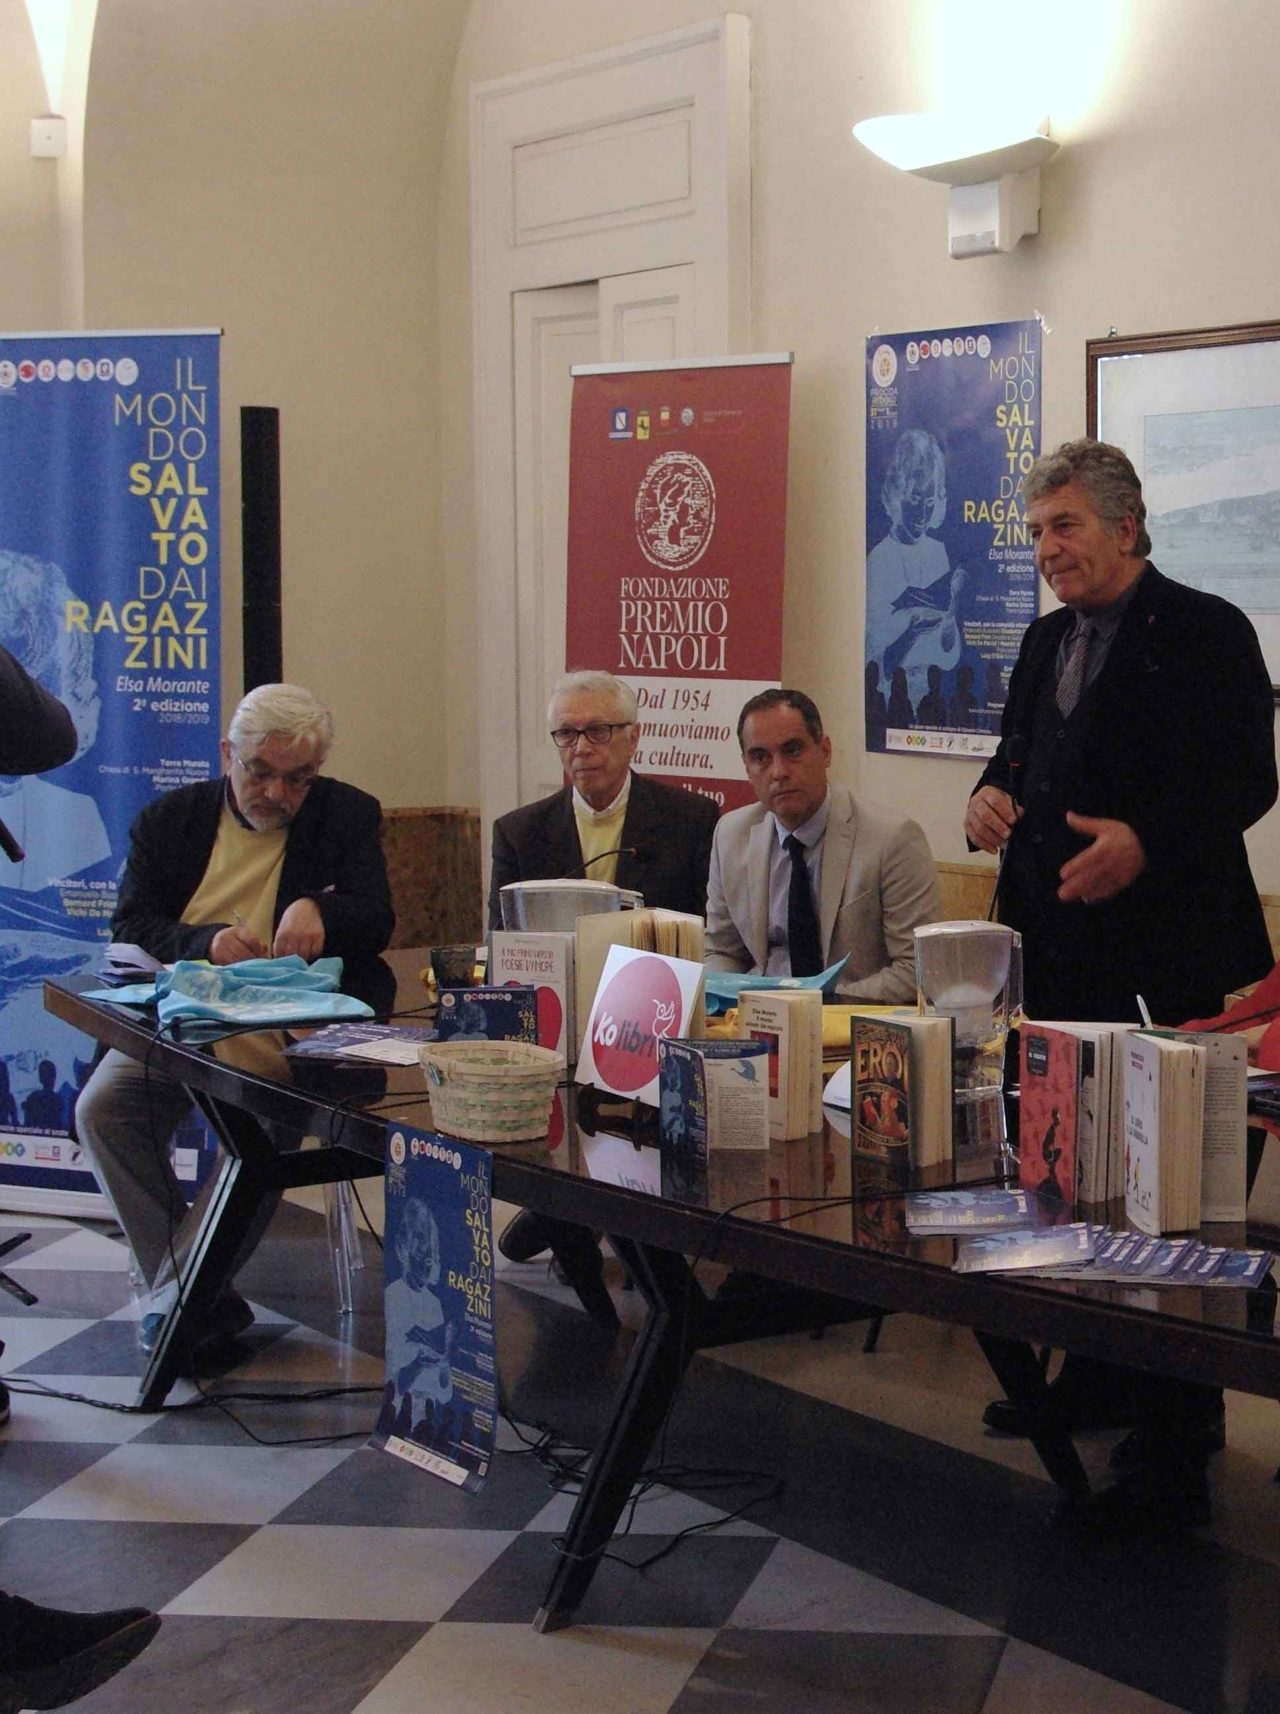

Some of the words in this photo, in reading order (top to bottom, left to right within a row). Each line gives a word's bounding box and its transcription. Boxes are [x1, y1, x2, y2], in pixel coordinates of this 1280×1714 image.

[1019, 332, 1035, 354] IL
[176, 358, 207, 390] IL
[990, 356, 1035, 380] MON
[1005, 379, 1035, 403] DO
[114, 393, 206, 426] MON
[996, 404, 1035, 428] SAL
[148, 429, 207, 461] DO
[1006, 428, 1034, 451] VA
[1006, 451, 1034, 474] TO
[129, 463, 208, 496] SAL
[1001, 476, 1026, 499] DA
[150, 498, 208, 530] VA
[151, 532, 208, 565] TO
[1004, 549, 1034, 560] Morante
[1006, 564, 1034, 573] edizione
[140, 567, 206, 600] DAI
[621, 577, 730, 599] FONDAZIONE
[65, 601, 208, 635] RAGAZ
[620, 601, 728, 634] PREMIO
[124, 636, 208, 670] ZINI
[618, 633, 728, 671] NAPOLI
[116, 676, 143, 692] Elsa
[147, 677, 210, 694] Morante
[150, 699, 209, 712] edizione
[637, 687, 666, 709] Dal
[672, 688, 712, 711] 1954
[638, 718, 731, 742] muoviamo
[650, 746, 714, 769] cultura.
[594, 1012, 656, 1058] Kolibri
[478, 1160, 488, 1180] IL
[460, 1172, 488, 1197] MON
[471, 1193, 489, 1214] DO
[465, 1209, 489, 1233] SAL
[472, 1227, 490, 1250] VA
[474, 1245, 491, 1267] TO
[470, 1262, 491, 1284] DAI
[448, 1270, 491, 1302] RAGAZ
[466, 1295, 491, 1319] ZINI
